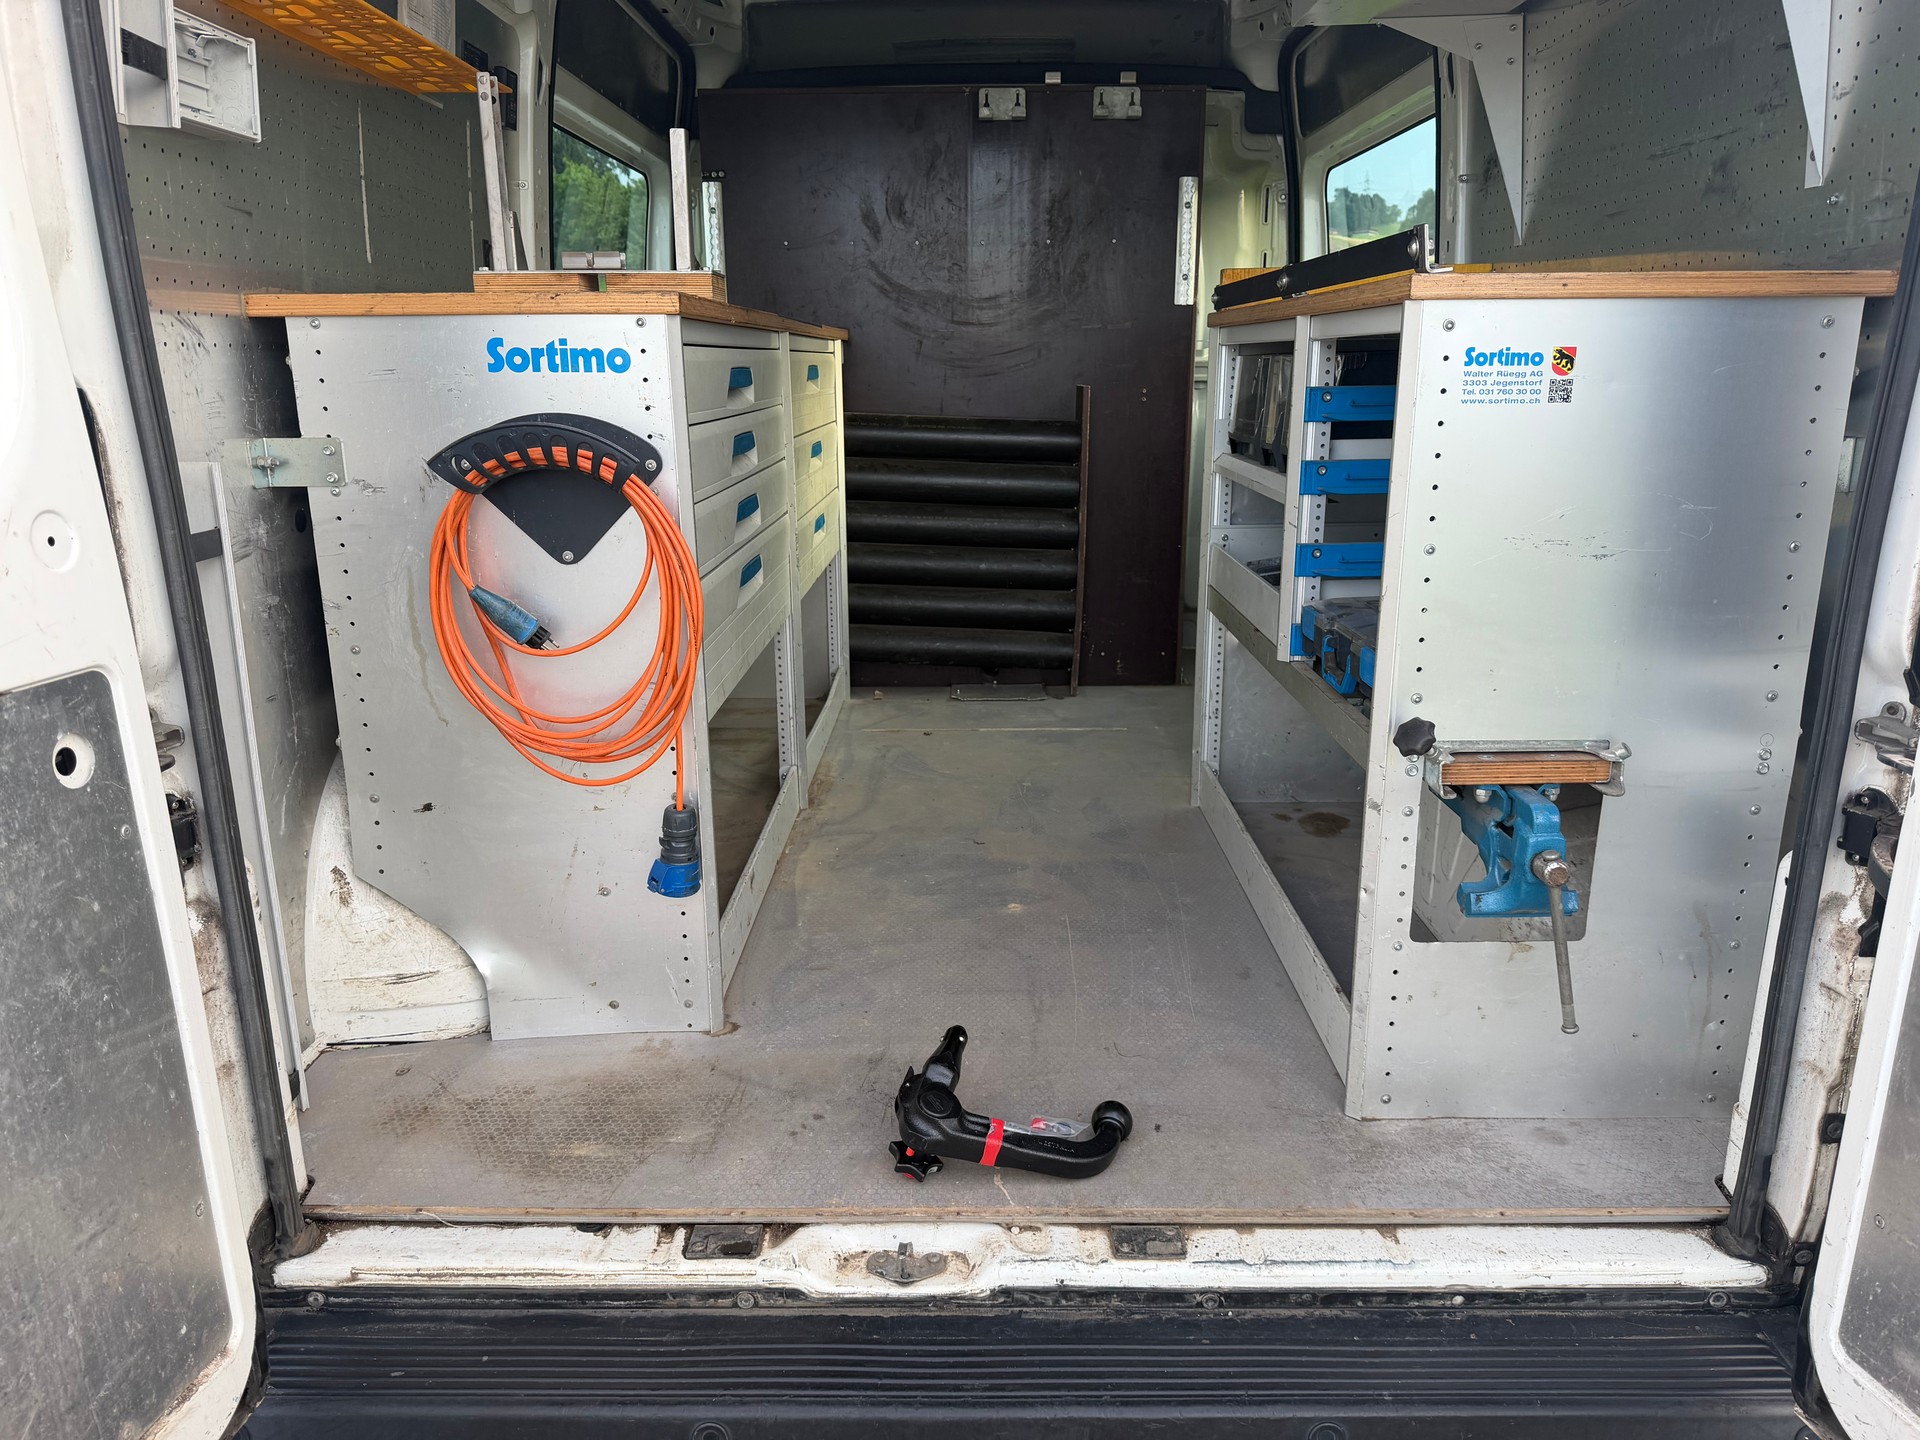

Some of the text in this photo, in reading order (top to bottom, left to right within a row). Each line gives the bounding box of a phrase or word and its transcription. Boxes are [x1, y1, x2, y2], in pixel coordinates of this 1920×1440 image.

[487, 337, 631, 373] Sortimo
[1464, 347, 1544, 366] Sortimo
[1497, 370, 1527, 378] Rüegg
